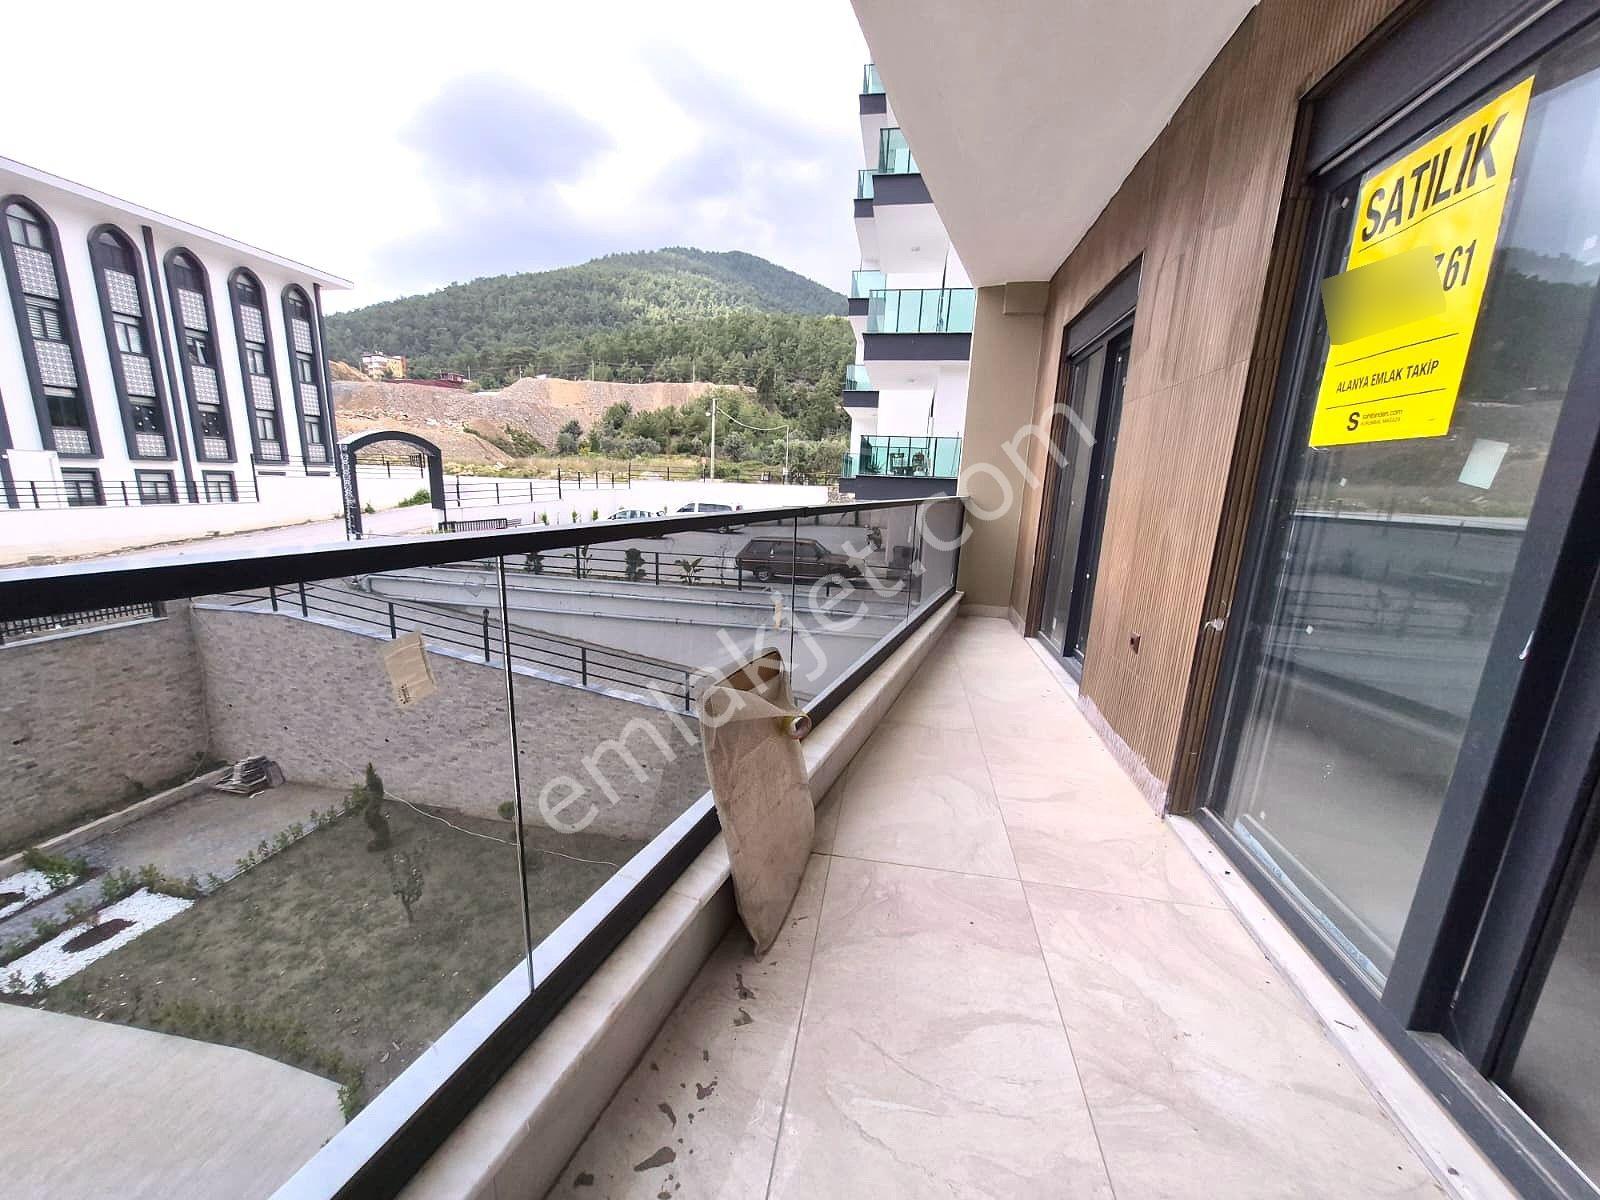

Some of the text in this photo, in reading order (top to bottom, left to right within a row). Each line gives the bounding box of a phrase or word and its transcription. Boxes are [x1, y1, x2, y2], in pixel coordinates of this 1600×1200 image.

[1361, 112, 1508, 243] SATILIK
[1336, 358, 1440, 393] ALANYA EMLAK TAKİP
